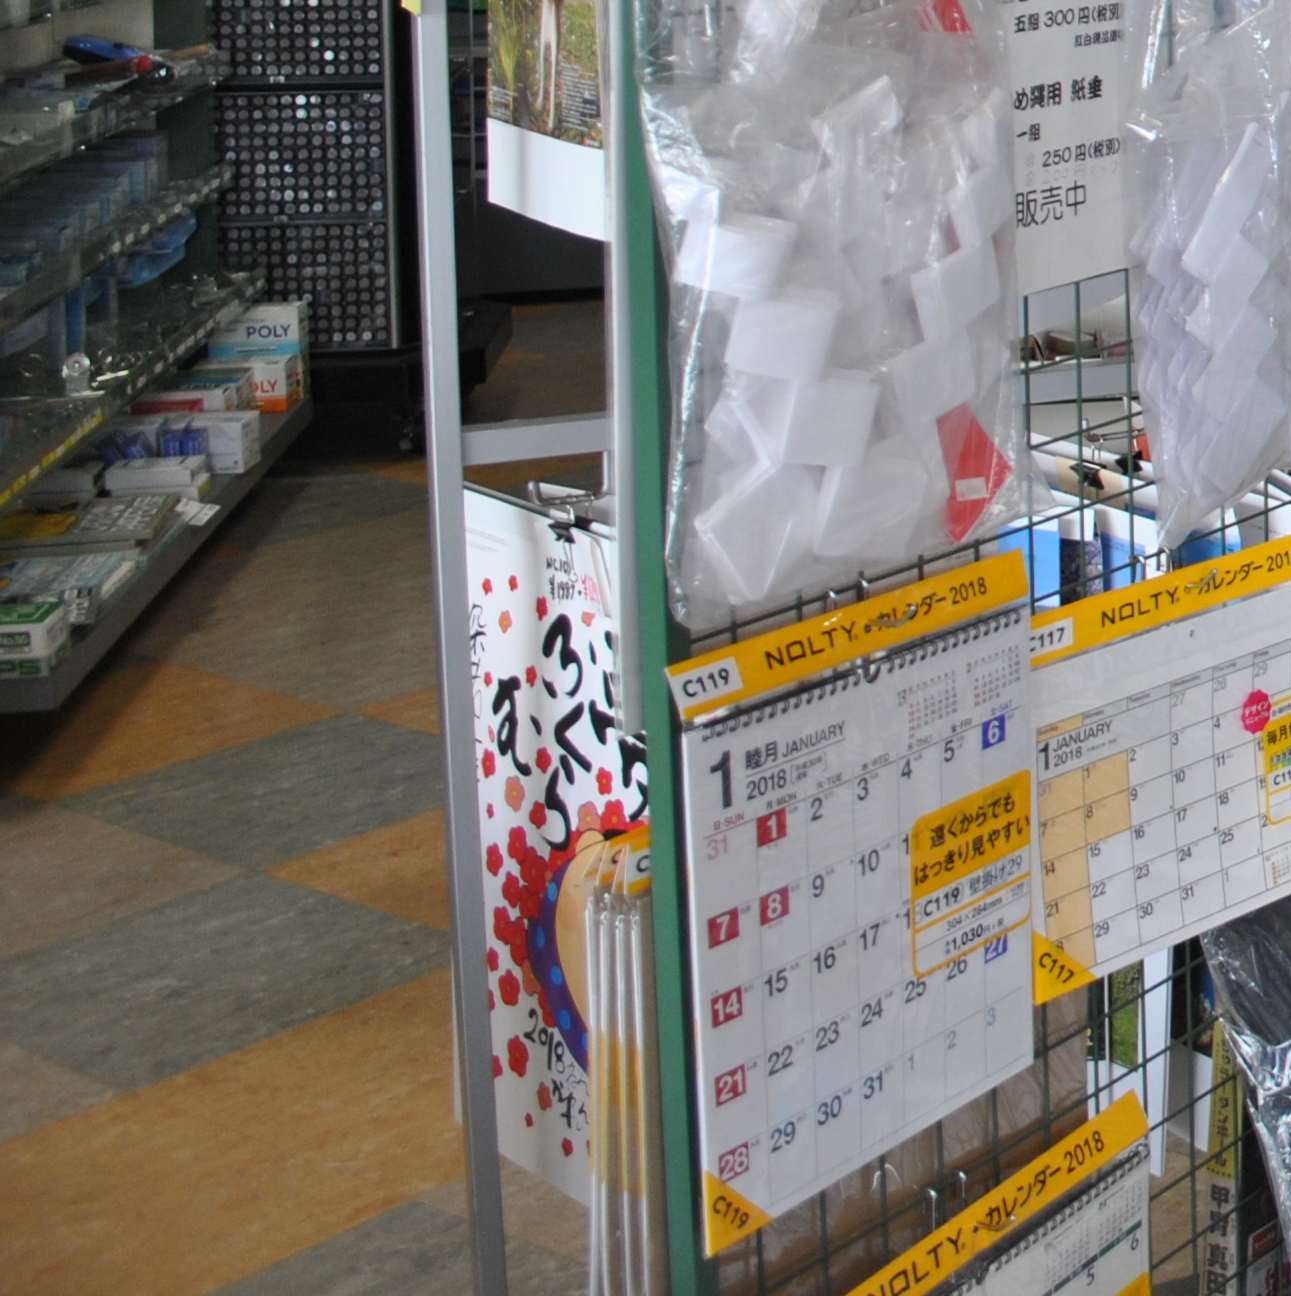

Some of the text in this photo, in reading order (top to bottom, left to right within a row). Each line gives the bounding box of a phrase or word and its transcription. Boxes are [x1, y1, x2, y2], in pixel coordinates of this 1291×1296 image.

[1014, 180, 1088, 228] 販売中
[245, 323, 292, 340] POLY
[249, 379, 279, 394] OLY
[764, 576, 988, 670] NOLTY 2018
[1101, 586, 1178, 628] NOLTY
[682, 667, 731, 698] C119
[1214, 676, 1228, 692] 28
[1244, 699, 1269, 718] デザイン
[782, 720, 847, 758] JANUARY
[1052, 719, 1114, 754] JANUARY
[1038, 740, 1051, 772] 1
[1053, 745, 1084, 769] 2018
[706, 720, 1000, 861] 31 1 2 3 4 5 6
[709, 749, 732, 810] 1
[745, 768, 789, 802] 2018
[929, 791, 1016, 850] 遠くからでも
[1219, 829, 1235, 846] 25
[914, 814, 1031, 887] はっきり見やすい
[1088, 842, 1101, 858] 15
[716, 848, 881, 942] 7 8 9 10
[923, 887, 960, 918] C119
[711, 922, 881, 1024] 14 15 16 17
[1038, 951, 1075, 985] C117
[717, 954, 968, 1102] 21 22 23 24 25 26
[719, 1069, 885, 1182] 28 29 30 31
[1063, 1130, 1106, 1175] 2018
[711, 1193, 750, 1230] C119
